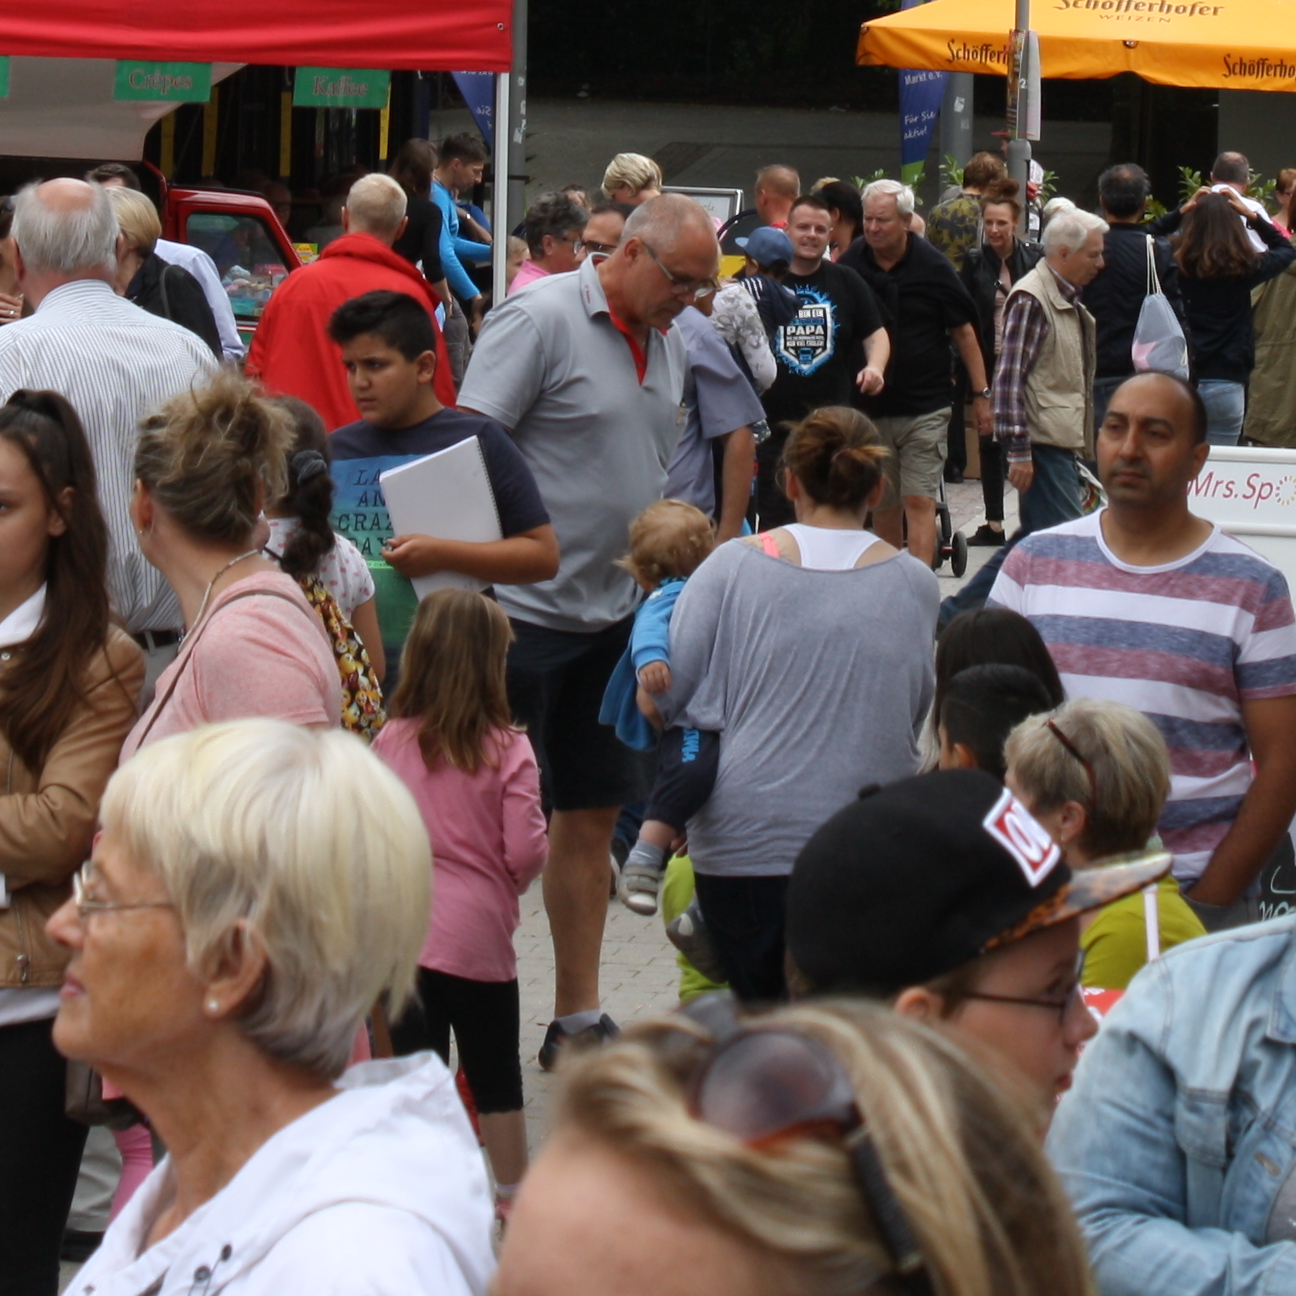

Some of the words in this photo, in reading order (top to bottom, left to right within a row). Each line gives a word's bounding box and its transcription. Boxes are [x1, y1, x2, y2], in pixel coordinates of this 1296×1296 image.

[1098, 14, 1171, 23] WEIZEN
[129, 69, 193, 95] Crêpes
[312, 76, 369, 97] Kaffee
[786, 325, 825, 335] PAPA
